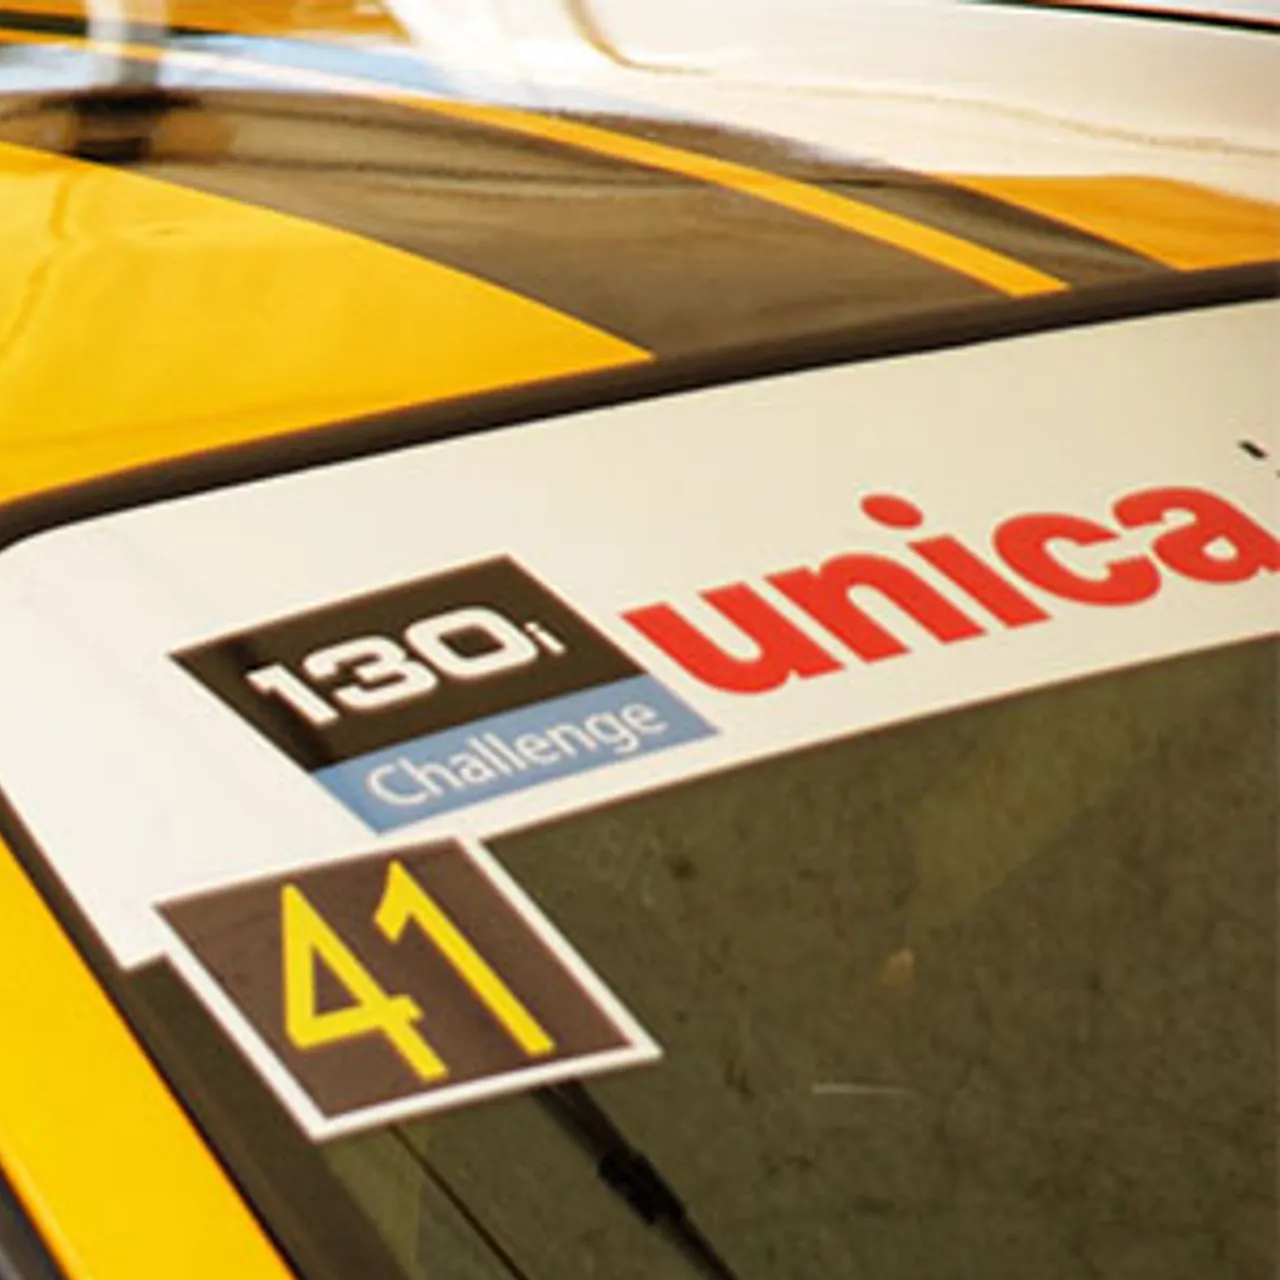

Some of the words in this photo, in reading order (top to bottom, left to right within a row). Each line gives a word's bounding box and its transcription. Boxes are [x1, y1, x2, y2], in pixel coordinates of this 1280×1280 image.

[621, 486, 1280, 694] unica
[366, 700, 668, 807] Challenge
[280, 860, 555, 1082] 41
